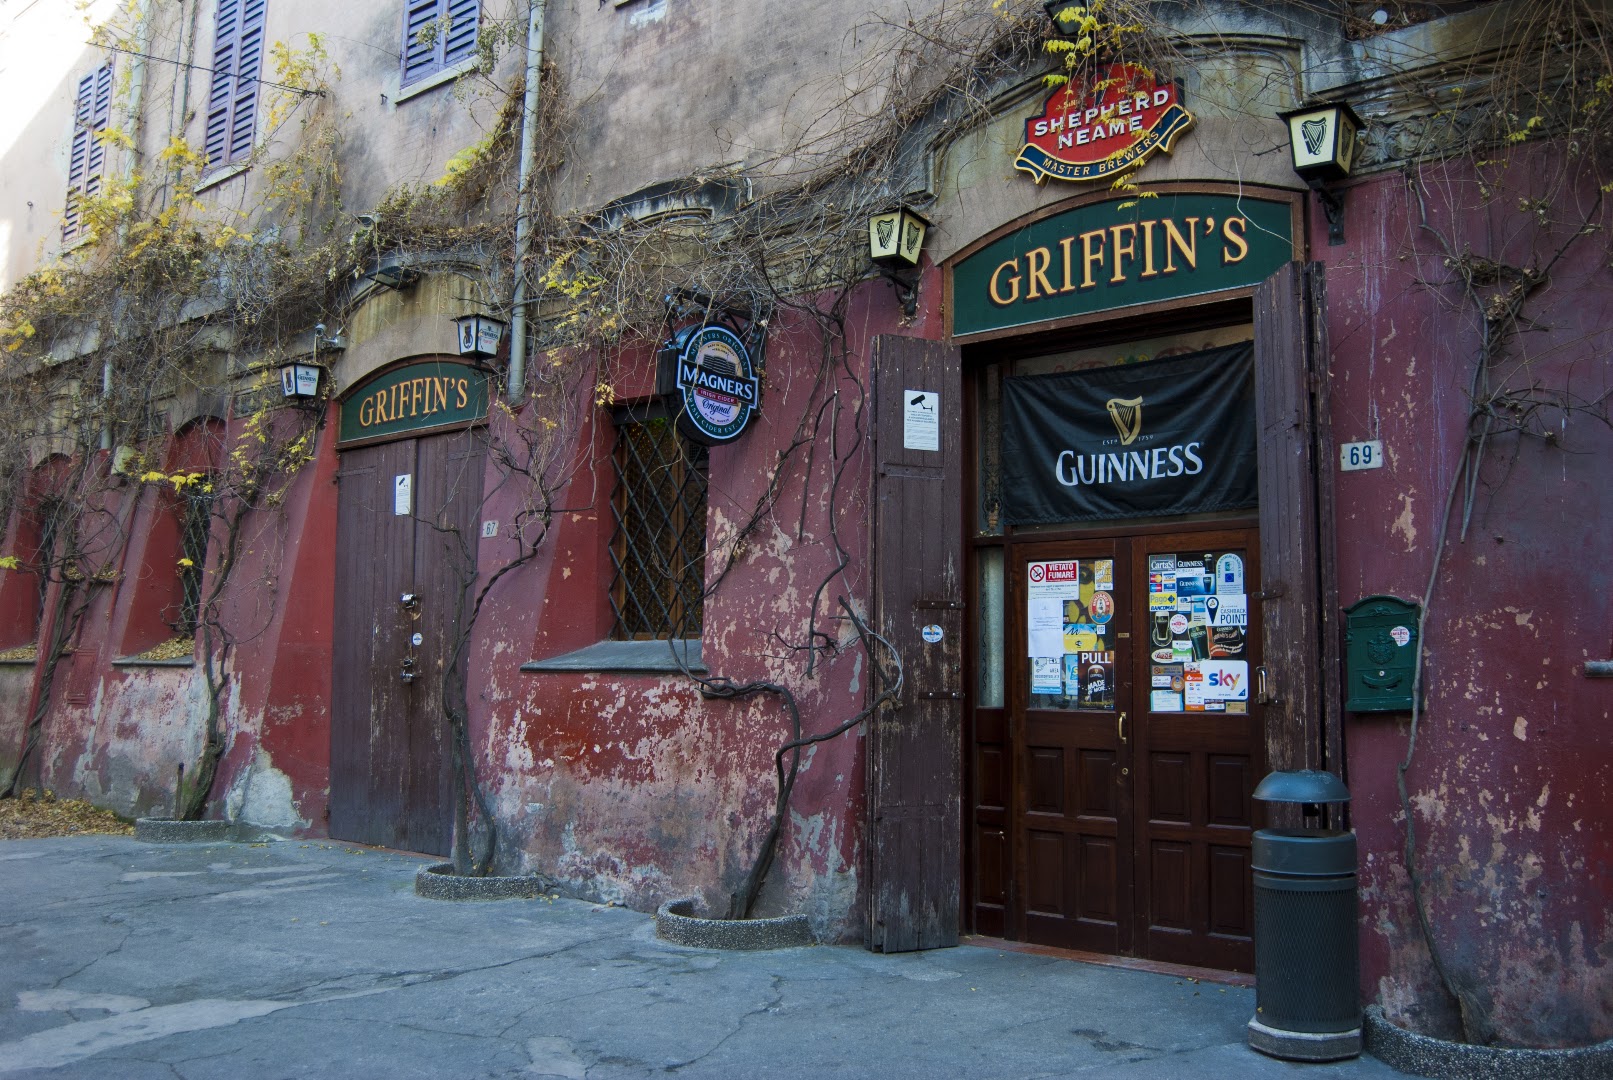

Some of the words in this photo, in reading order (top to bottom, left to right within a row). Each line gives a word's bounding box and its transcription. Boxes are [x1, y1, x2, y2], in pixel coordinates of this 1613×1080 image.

[1034, 90, 1169, 137] SHEPHERD
[1058, 115, 1144, 150] NEAME
[1042, 158, 1090, 177] MASTER
[1099, 132, 1160, 173] BREWERS
[988, 216, 1249, 305] GRIFFIN'S
[683, 364, 753, 400] MAGNERS
[700, 390, 716, 399] IRISH
[359, 377, 468, 427] GRIFFIN'S
[702, 398, 732, 415] Original
[701, 419, 722, 433] CIDER
[1138, 434, 1154, 442] 1759
[1350, 445, 1372, 466] 69
[1055, 442, 1203, 487] GUINNESS
[486, 522, 496, 535] 67
[1048, 563, 1074, 571] VIETATO
[1177, 560, 1204, 568] GUINNESS
[1048, 571, 1075, 579] FUMARE
[1150, 595, 1168, 605] Pago
[1220, 614, 1247, 625] POINT
[1081, 652, 1112, 664] PULL
[1087, 679, 1106, 690] MADE
[1208, 669, 1241, 691] sky
